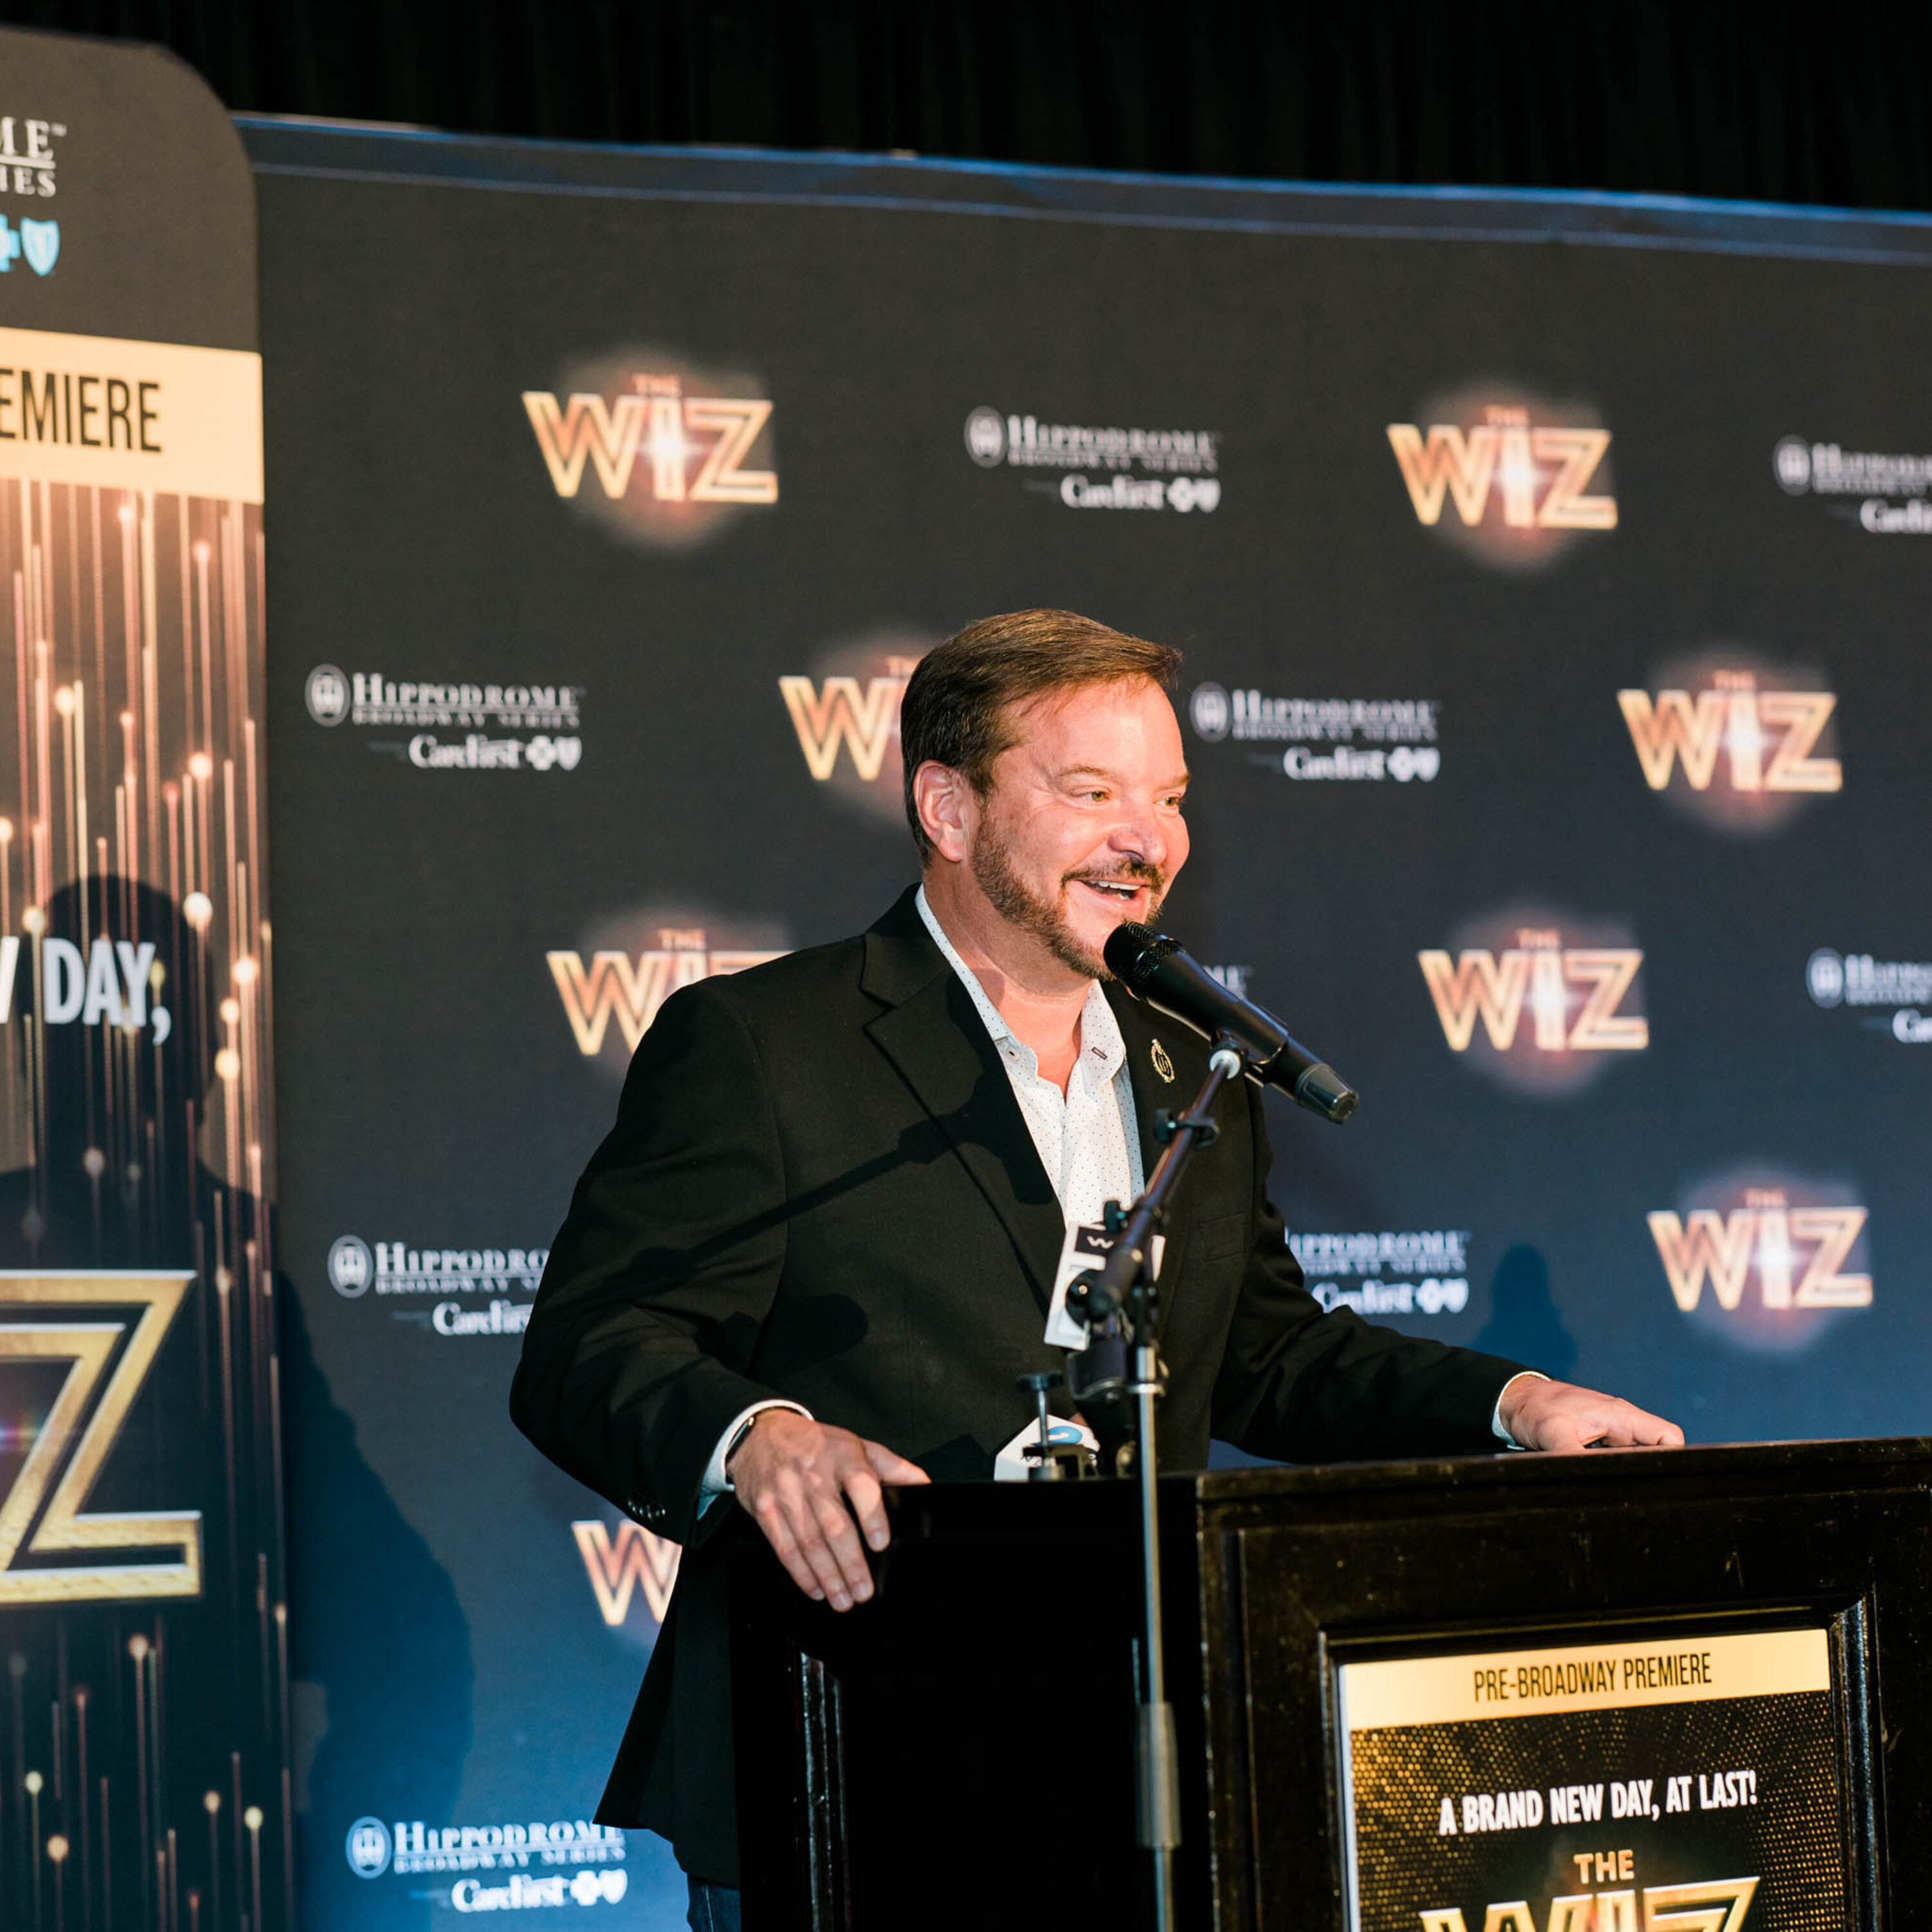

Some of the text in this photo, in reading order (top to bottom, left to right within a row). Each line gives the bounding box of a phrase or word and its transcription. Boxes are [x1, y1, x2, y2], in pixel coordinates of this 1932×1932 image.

[522, 391, 778, 504] WIZ
[1387, 423, 1618, 529] WIZ
[1617, 689, 1842, 792] WIZ
[43, 938, 171, 1045] DAY,
[1418, 949, 1649, 1052] WIZ
[1647, 1206, 1873, 1312] WIZ
[1474, 1653, 1712, 1701] PRE-BROADWAY PREMIERE
[1439, 1770, 1757, 1836] A BRAND NEW DAY, AT LAST!
[1573, 1849, 1635, 1884] THE
